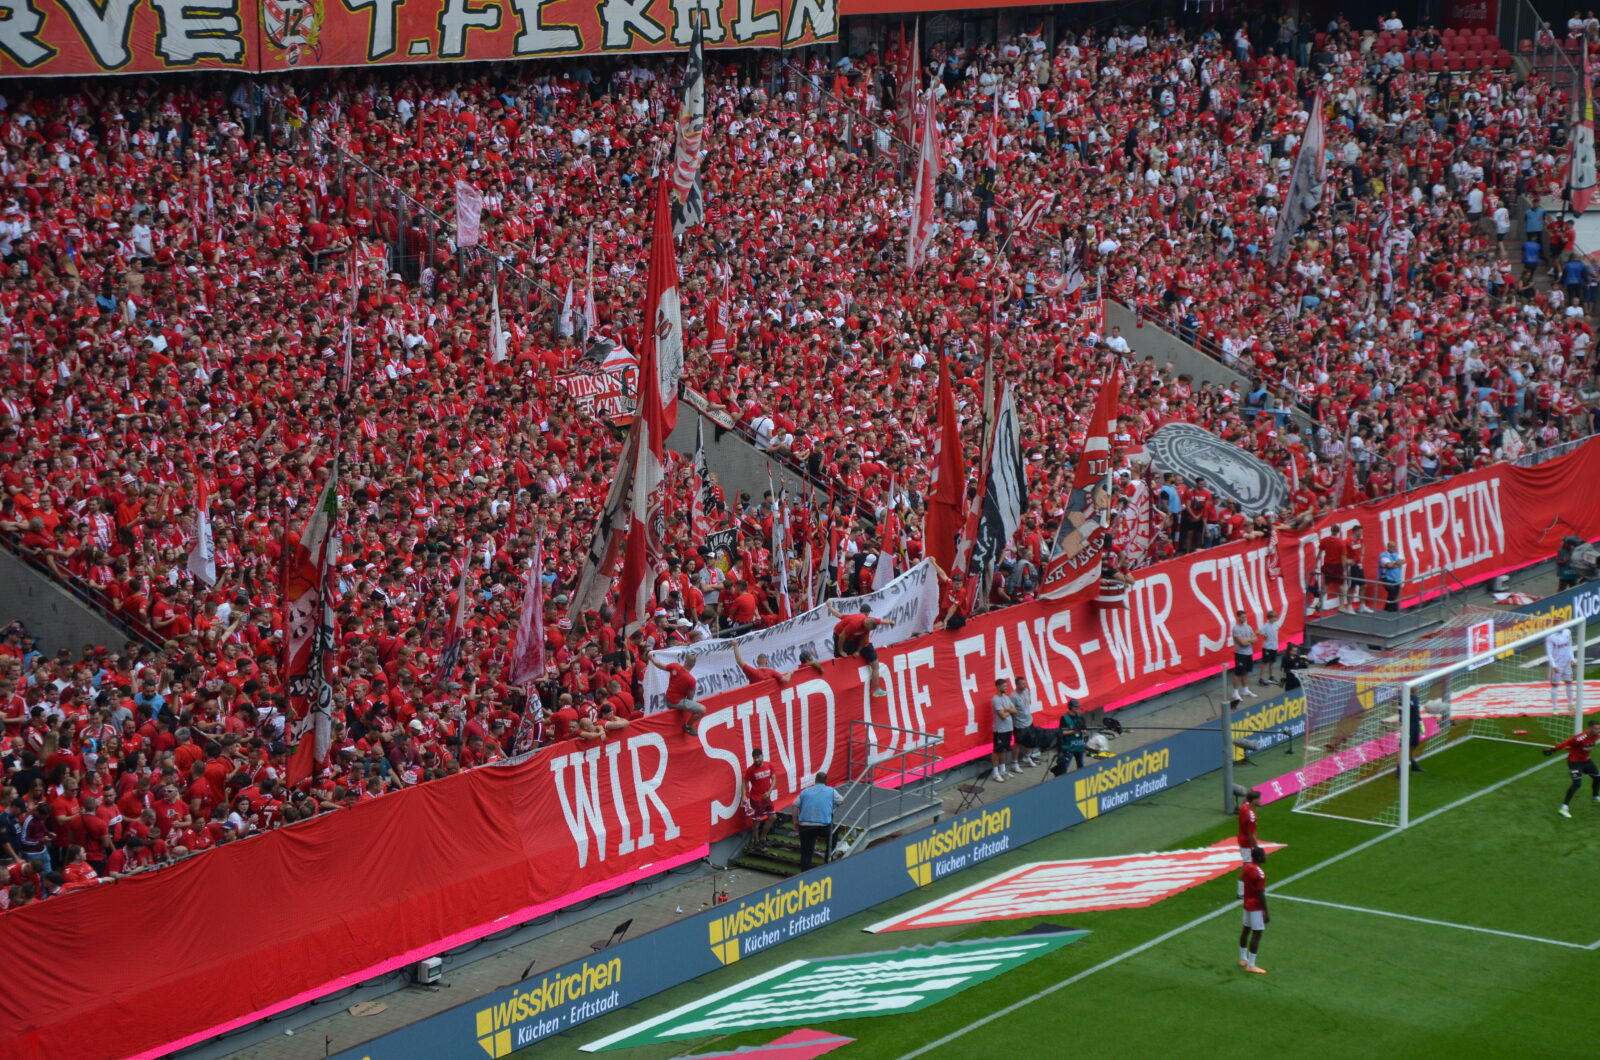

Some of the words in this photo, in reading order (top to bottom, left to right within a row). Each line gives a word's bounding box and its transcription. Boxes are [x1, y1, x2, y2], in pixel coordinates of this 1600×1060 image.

[283, 7, 303, 36] 12
[550, 731, 681, 869] WIR
[697, 678, 836, 827] SIND
[858, 645, 945, 766] DIE
[1188, 545, 1289, 657] SIND
[1378, 477, 1506, 587] VEREIN
[1085, 748, 1169, 798] wisskirchen
[1101, 790, 1129, 811] Küchen
[1135, 773, 1168, 798] Erftstadt
[917, 808, 1011, 863] wisskirchen
[935, 853, 966, 877] Küchen
[973, 836, 1009, 862] Erftstadt
[723, 877, 832, 940] wisskirchen
[744, 928, 781, 955] Küchen
[789, 906, 831, 936] Erftstadt
[493, 957, 621, 1031] wisskirchen
[518, 1019, 559, 1046] Küchen
[570, 990, 619, 1024] Erftstadt
